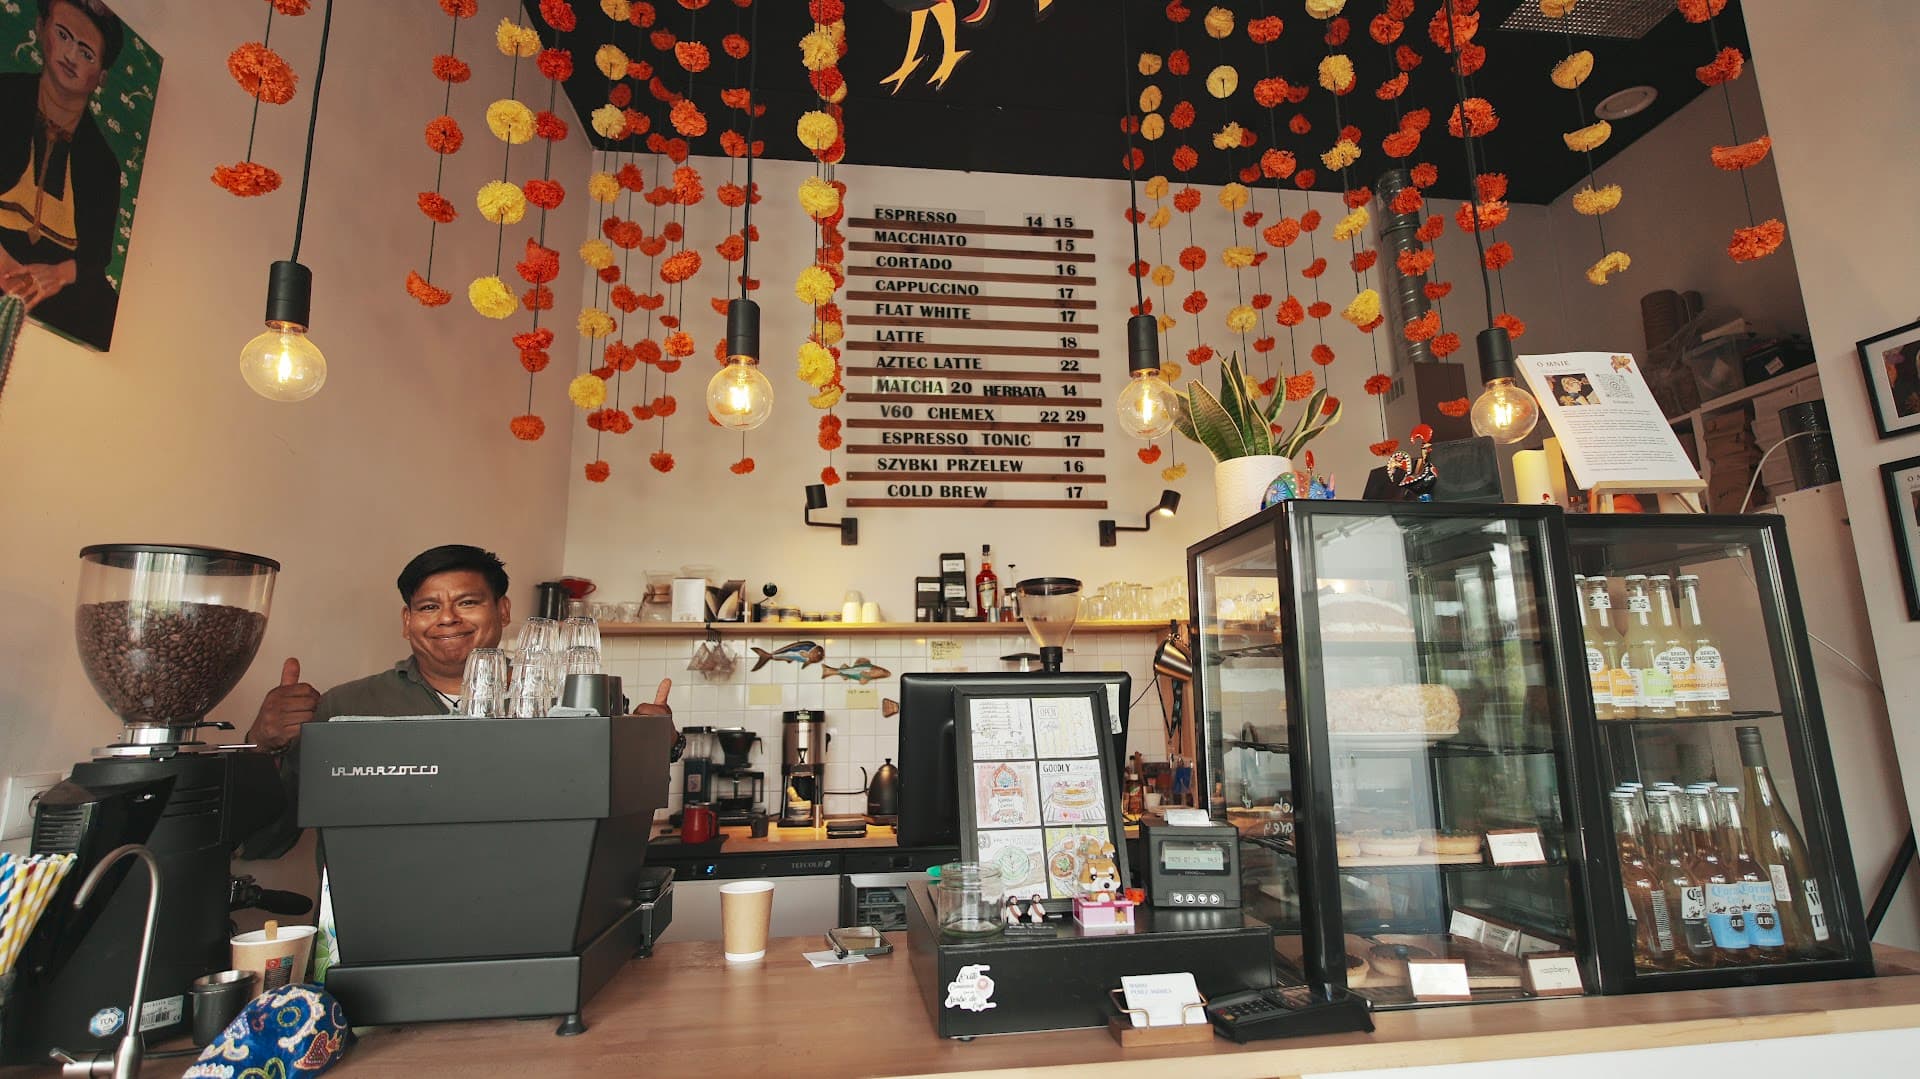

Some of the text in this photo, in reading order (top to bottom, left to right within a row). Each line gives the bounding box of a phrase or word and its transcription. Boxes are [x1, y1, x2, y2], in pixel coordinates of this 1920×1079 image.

[875, 208, 1074, 228] ESPRESSO 14 15
[874, 231, 1074, 251] MACCHIATO 15
[876, 255, 1076, 276] CORTADO 16
[875, 279, 1074, 299] CAPPUCCINO 17
[875, 303, 1076, 322] FLAT WHITE 17
[876, 330, 1077, 348] LATTE 18
[876, 356, 1080, 371] AZTEC LATTE 22
[876, 379, 944, 394] MATCHA
[951, 382, 972, 394] 20
[1061, 385, 1077, 396] 14
[880, 404, 1086, 423] V60 CHEMEX 22 29
[882, 432, 1081, 447] ESPRESSO TONIC 17
[877, 458, 1084, 472] SZYBKI PRZELEW 16
[887, 485, 1083, 498] COLD BREW 17
[331, 765, 439, 776] LA MARZOCCO
